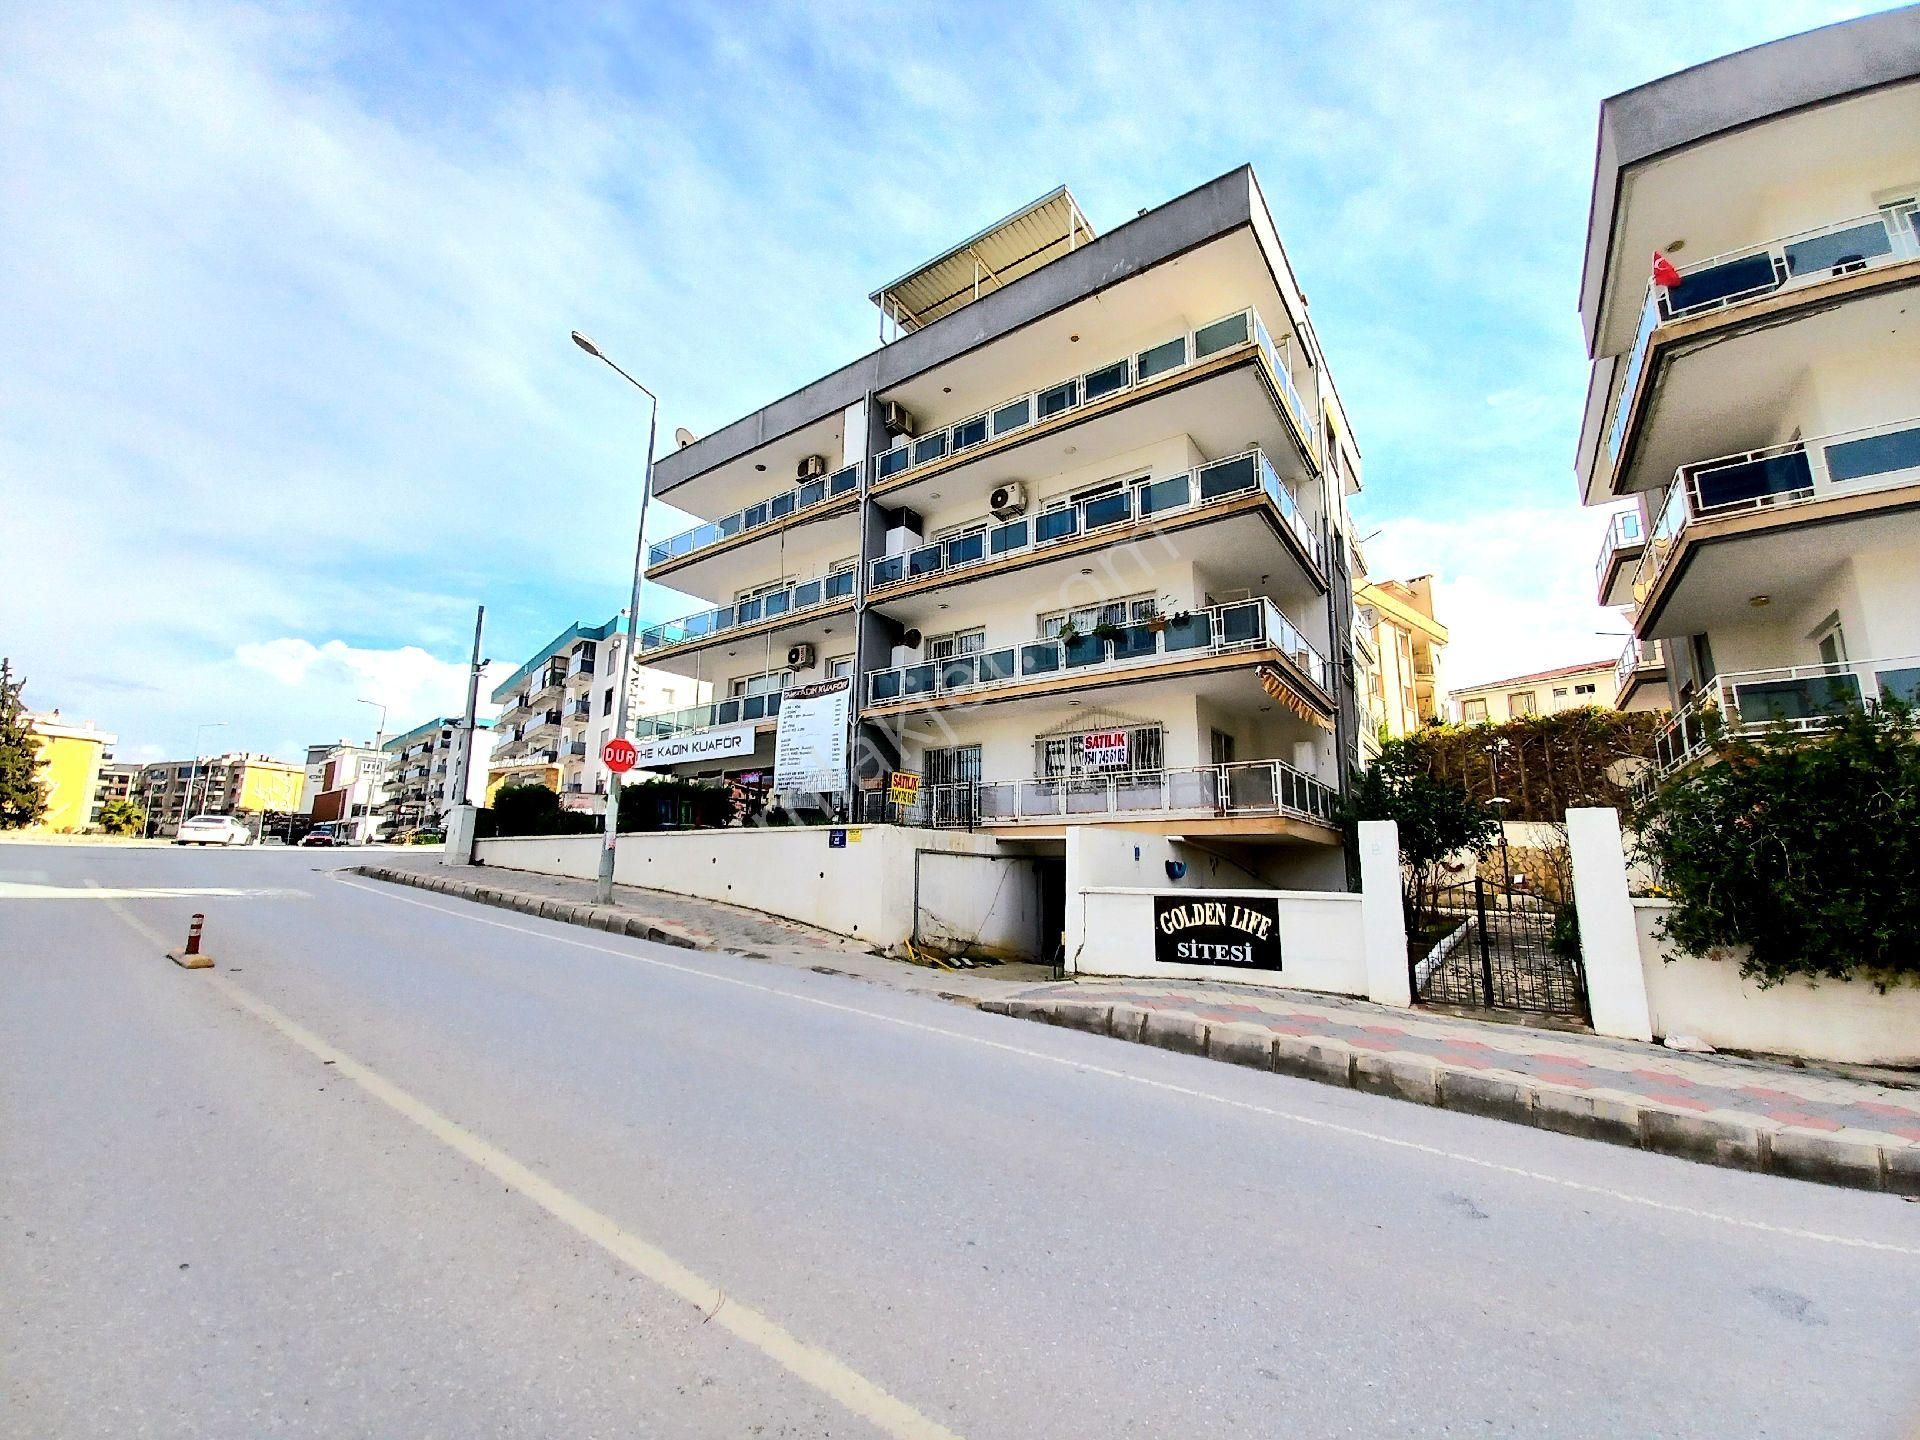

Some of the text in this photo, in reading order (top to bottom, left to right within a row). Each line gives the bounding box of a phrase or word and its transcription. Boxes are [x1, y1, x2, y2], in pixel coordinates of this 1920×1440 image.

[657, 744, 689, 757] KADIN
[692, 735, 742, 752] KUAFÖR
[1085, 733, 1125, 750] SATILIK
[605, 747, 635, 765] DUR
[1160, 902, 1272, 941] GOLDEN LIFE
[1177, 938, 1254, 963] SİTESİ
